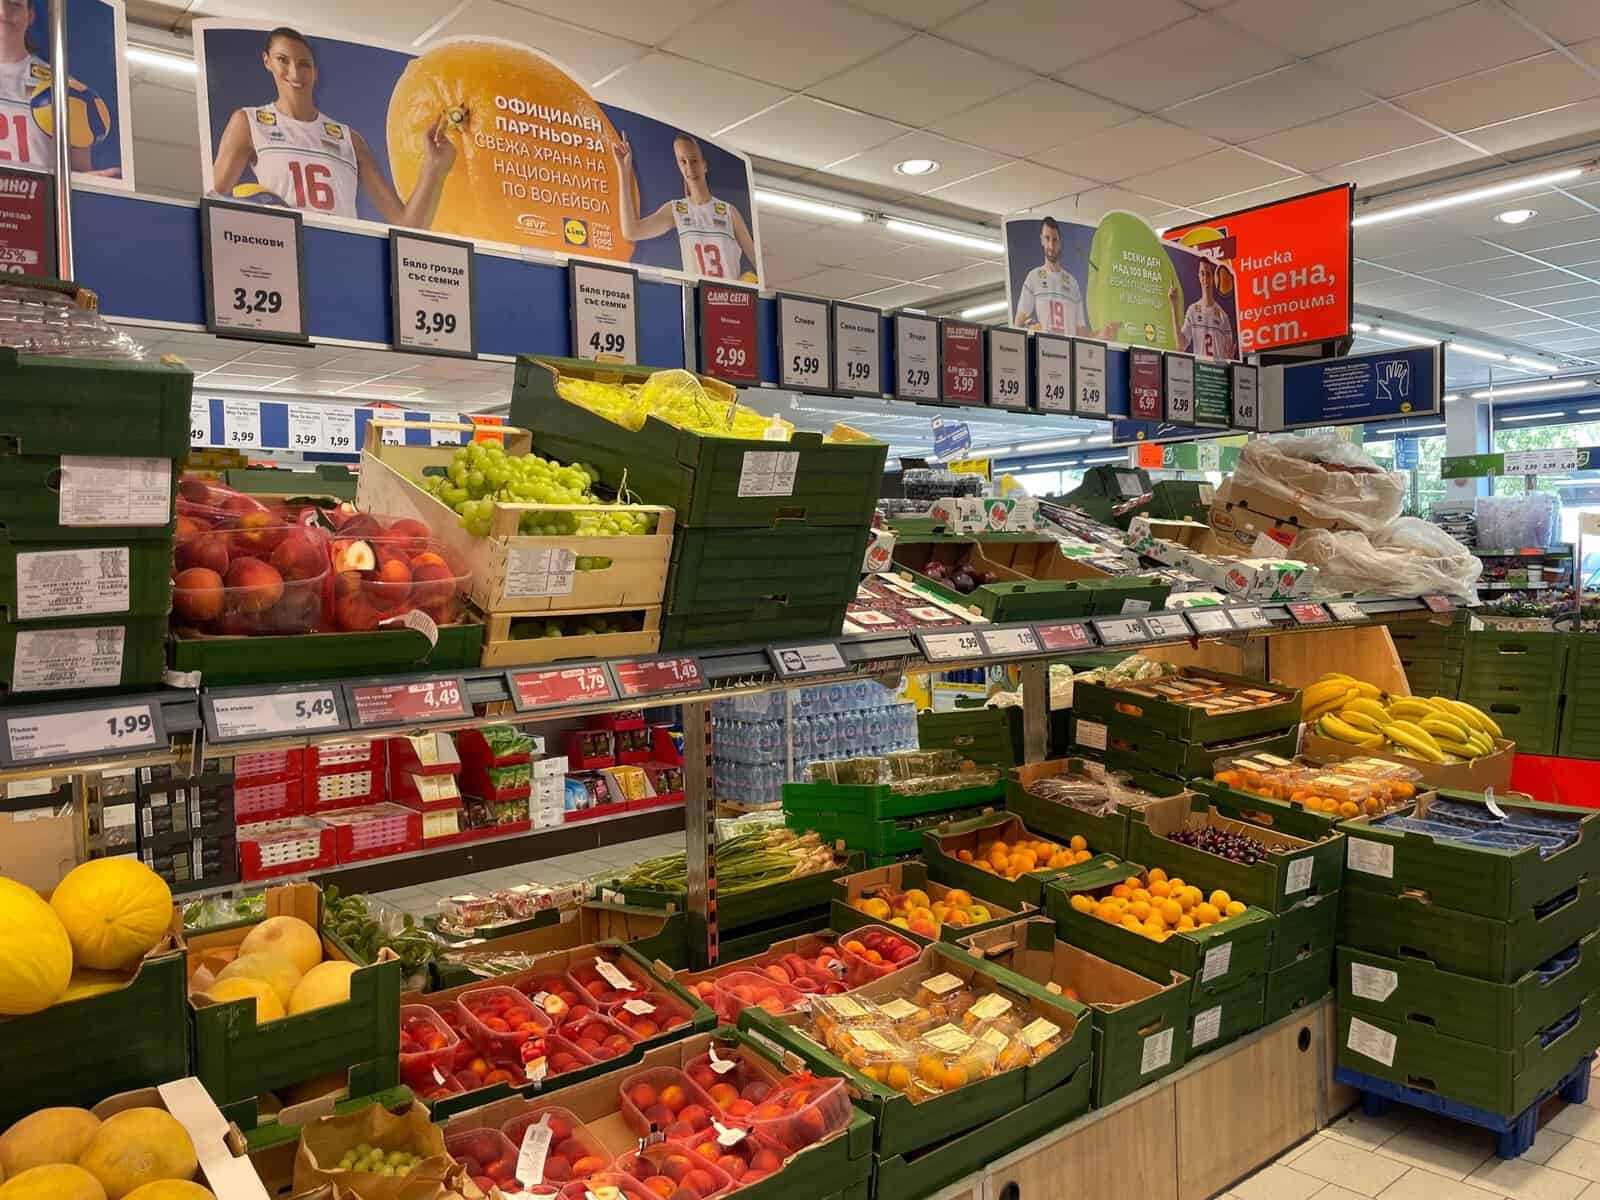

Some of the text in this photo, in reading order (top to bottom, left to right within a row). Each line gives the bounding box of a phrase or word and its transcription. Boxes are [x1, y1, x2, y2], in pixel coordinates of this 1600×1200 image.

[495, 95, 602, 134] ОФИЦИАЛЕН
[495, 116, 605, 153] ПАРТНЬОР ЗА
[475, 132, 607, 174] СВЕЖА ХРАНА НА
[288, 160, 335, 210] 16
[494, 159, 609, 194] НАЦИОНАЛИТЕ
[502, 181, 611, 215] ПО ВОЛЕЙБОЛ
[223, 230, 285, 249] Праскови
[402, 257, 465, 276] Бяло грозде
[694, 243, 724, 278] 13
[1240, 250, 1293, 272] Ниска
[408, 271, 461, 287] със семки
[1252, 263, 1336, 299] цена,
[233, 287, 282, 314] 3,29
[602, 289, 631, 301] грозде
[415, 310, 457, 334] 3,99
[590, 331, 625, 353] 4,99
[716, 346, 746, 366] 2,99
[792, 355, 819, 375] 5,99
[847, 361, 870, 380] 1,99
[907, 368, 930, 386] 2,79
[953, 376, 974, 393] 3,99
[999, 379, 1020, 396] 3,99
[1045, 384, 1065, 399] 2,49
[1082, 387, 1100, 402] 3,49
[1173, 398, 1189, 412] 2,99
[231, 431, 255, 442] 3,99
[295, 434, 317, 445] 3,99
[329, 436, 350, 447] 1,99
[671, 664, 698, 681] 1,49
[577, 674, 605, 694] 1,79
[295, 698, 335, 719] 5,49
[423, 688, 460, 709] 4,49
[107, 713, 151, 737] 1,99
